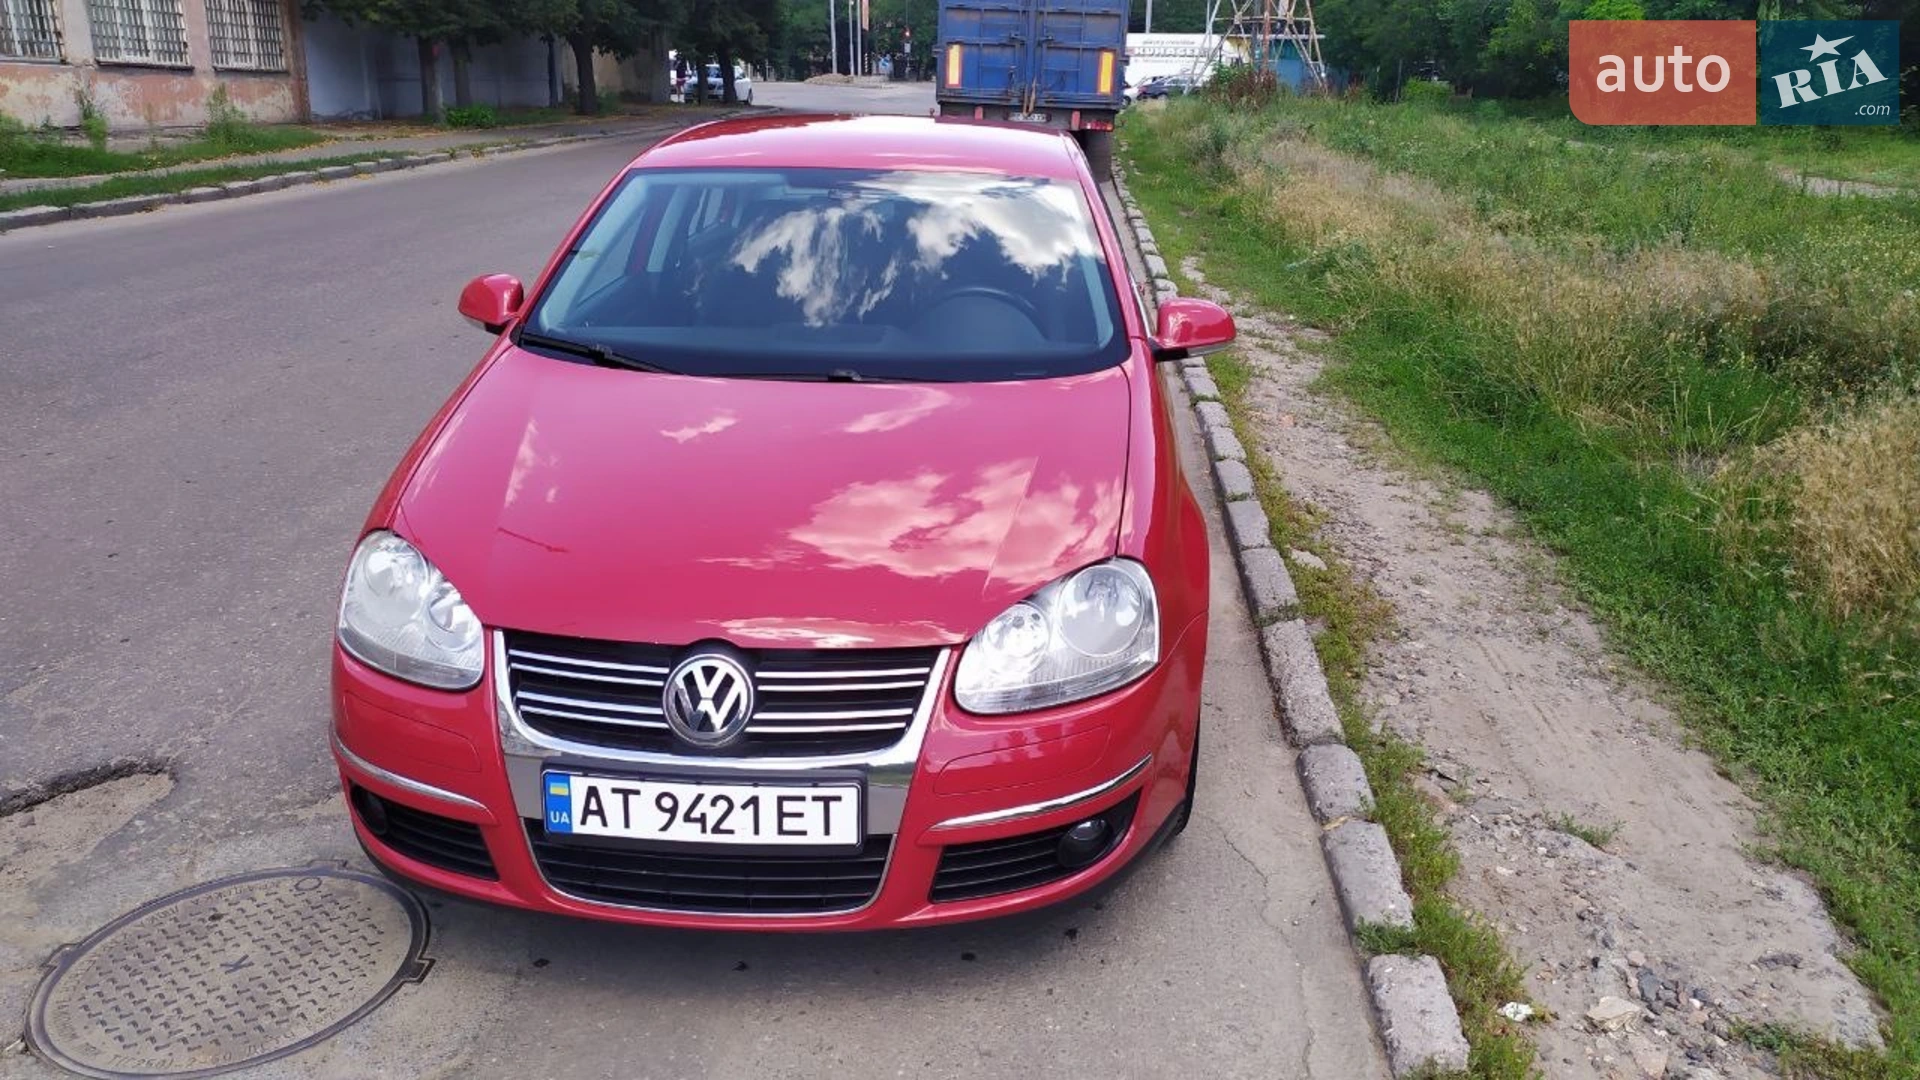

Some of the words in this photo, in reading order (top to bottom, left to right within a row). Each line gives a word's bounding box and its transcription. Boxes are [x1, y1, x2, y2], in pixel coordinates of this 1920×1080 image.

[551, 811, 570, 825] UA
[580, 785, 641, 829] AT
[655, 791, 761, 836] 9421
[776, 795, 843, 837] ET
